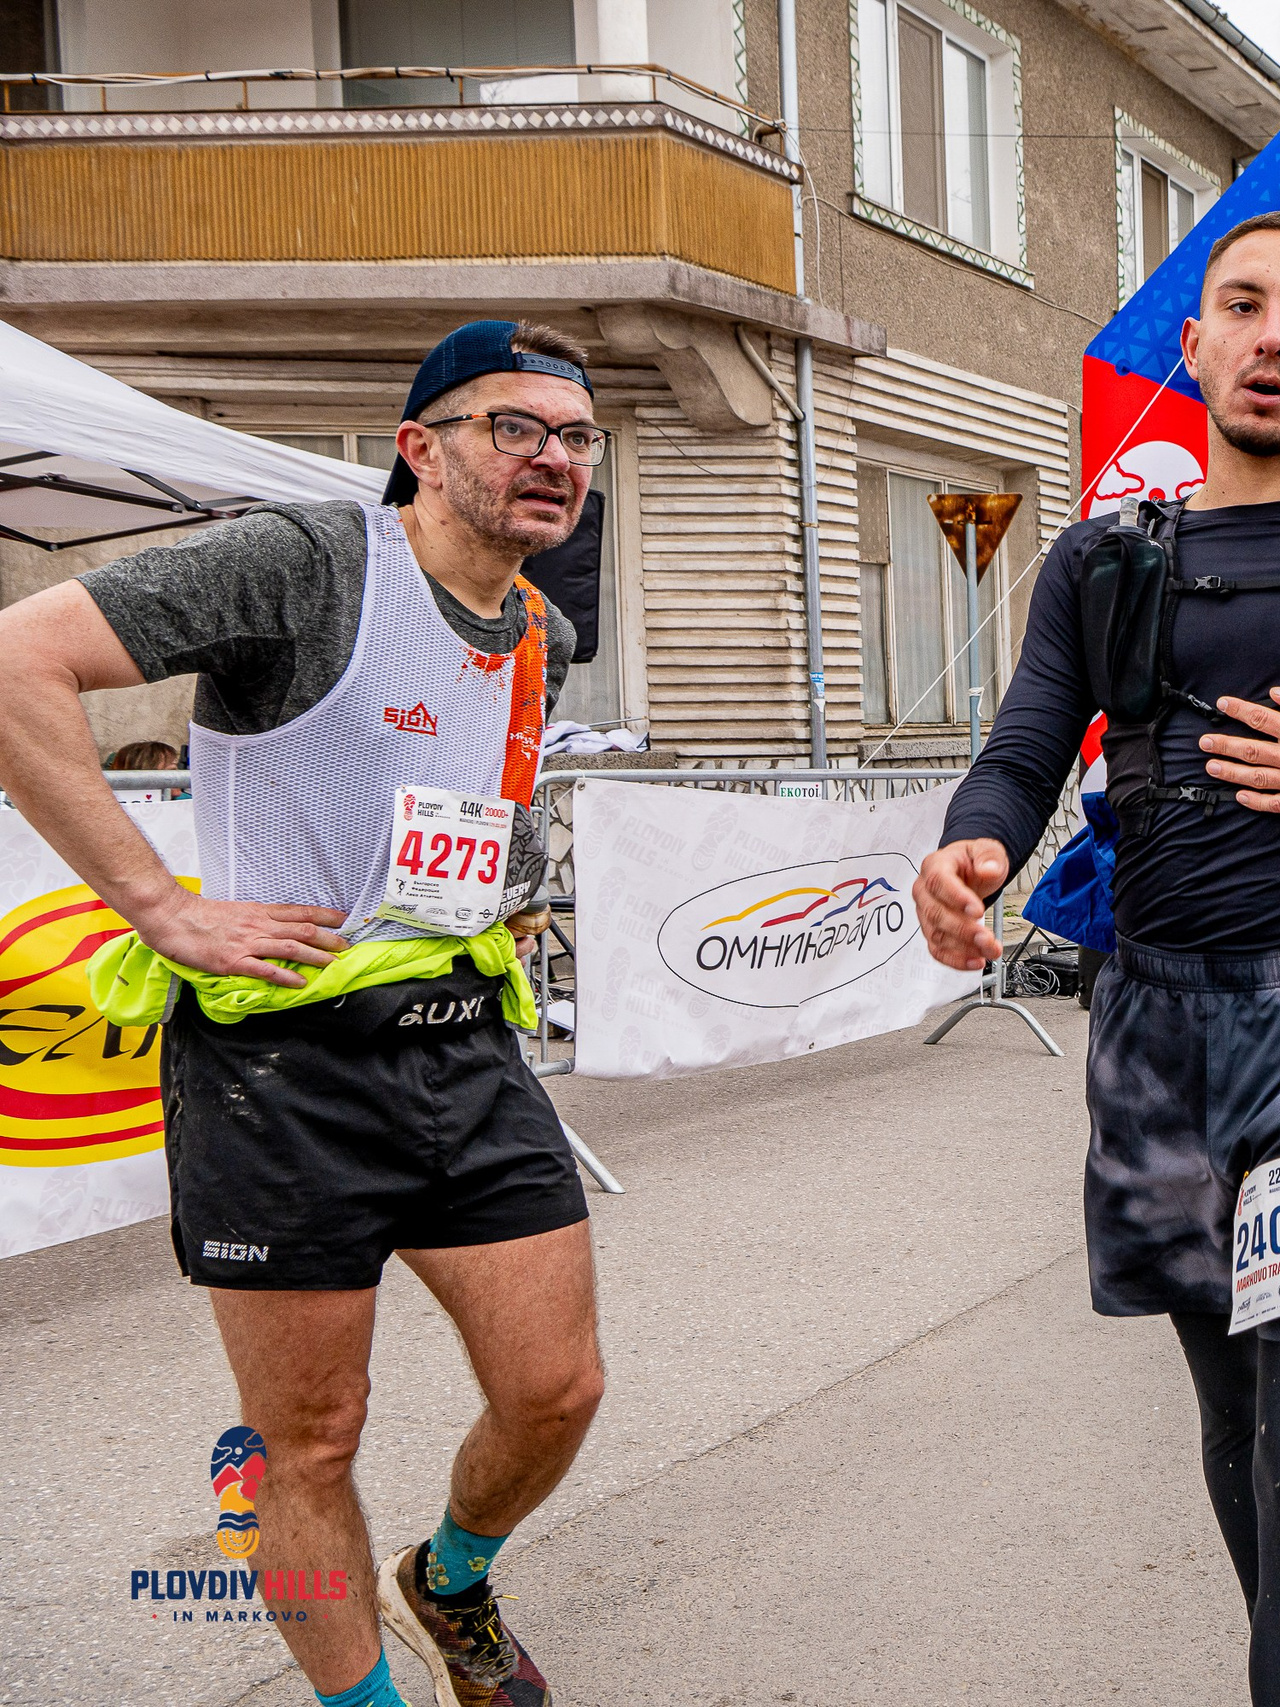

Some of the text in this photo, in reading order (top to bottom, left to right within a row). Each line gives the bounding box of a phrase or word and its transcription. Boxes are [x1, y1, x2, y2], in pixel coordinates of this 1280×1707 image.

[418, 802, 443, 811] PLOVDIV
[459, 801, 484, 818] 44K
[397, 830, 501, 885] 4273
[612, 834, 658, 867] HILLS
[1236, 1267, 1267, 1293] MARKOVO
